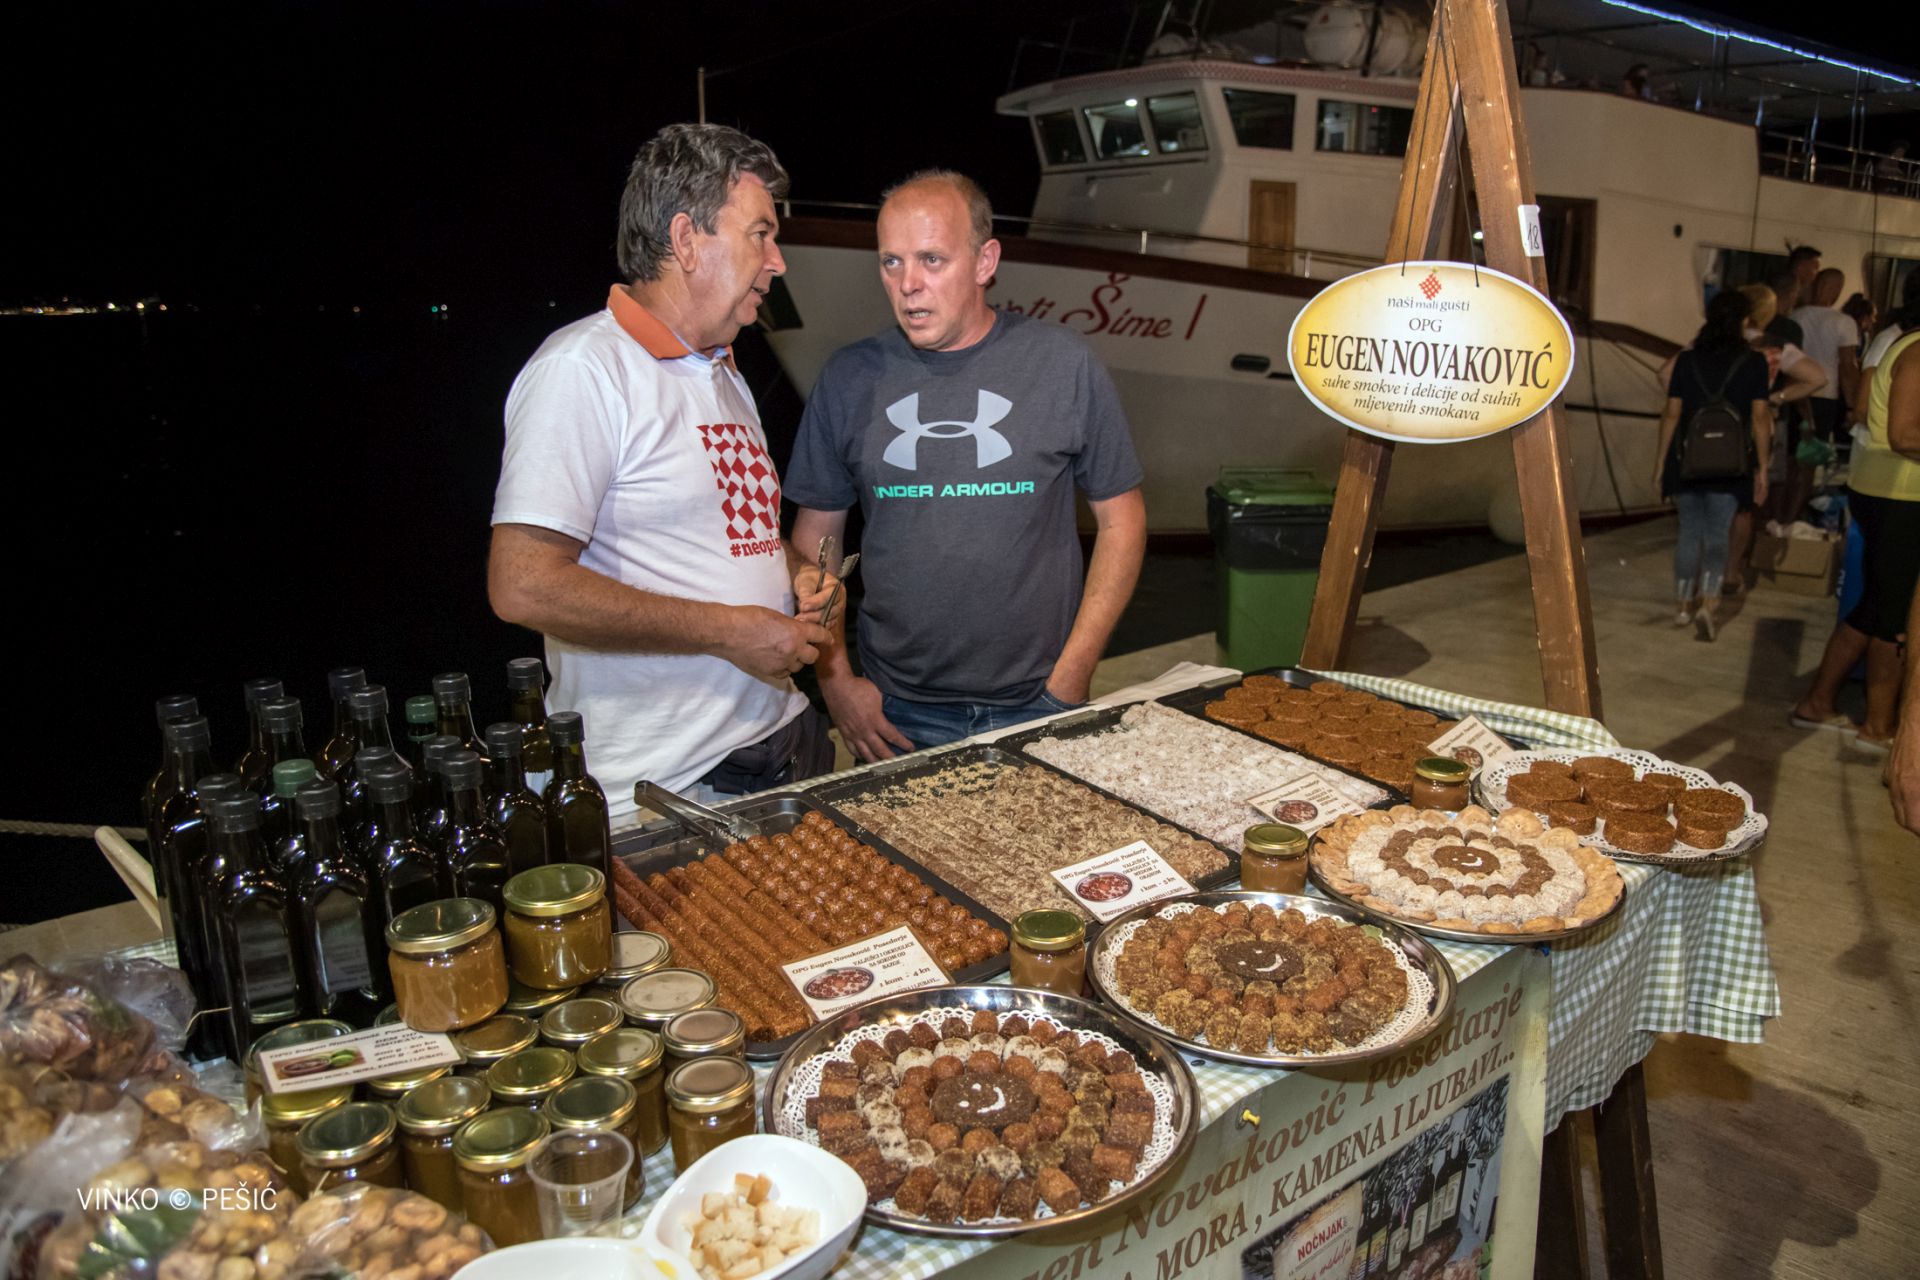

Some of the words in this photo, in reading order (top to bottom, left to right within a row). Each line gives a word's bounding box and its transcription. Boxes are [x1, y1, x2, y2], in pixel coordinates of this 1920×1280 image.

[1387, 296, 1414, 309] naši
[1415, 300, 1439, 310] mali
[1408, 317, 1442, 333] OPG
[1304, 333, 1388, 374] EUGEN
[1389, 340, 1553, 389] NOVAKOVIĆ
[1321, 374, 1350, 390] suhe
[1352, 379, 1401, 396] smokve
[1403, 382, 1410, 396] i
[1411, 384, 1458, 404] delicije
[1461, 388, 1480, 403] od
[1481, 391, 1521, 408] suhih
[1353, 395, 1417, 415] mljevenih
[1418, 404, 1480, 421] smokava
[940, 481, 1035, 498] ARMOUR
[885, 976, 903, 986] kom
[1113, 1081, 1347, 1257] Novaković
[1360, 982, 1524, 1108] Posedarje
[1268, 1114, 1387, 1218] KAMENA
[1390, 1103, 1404, 1141] I
